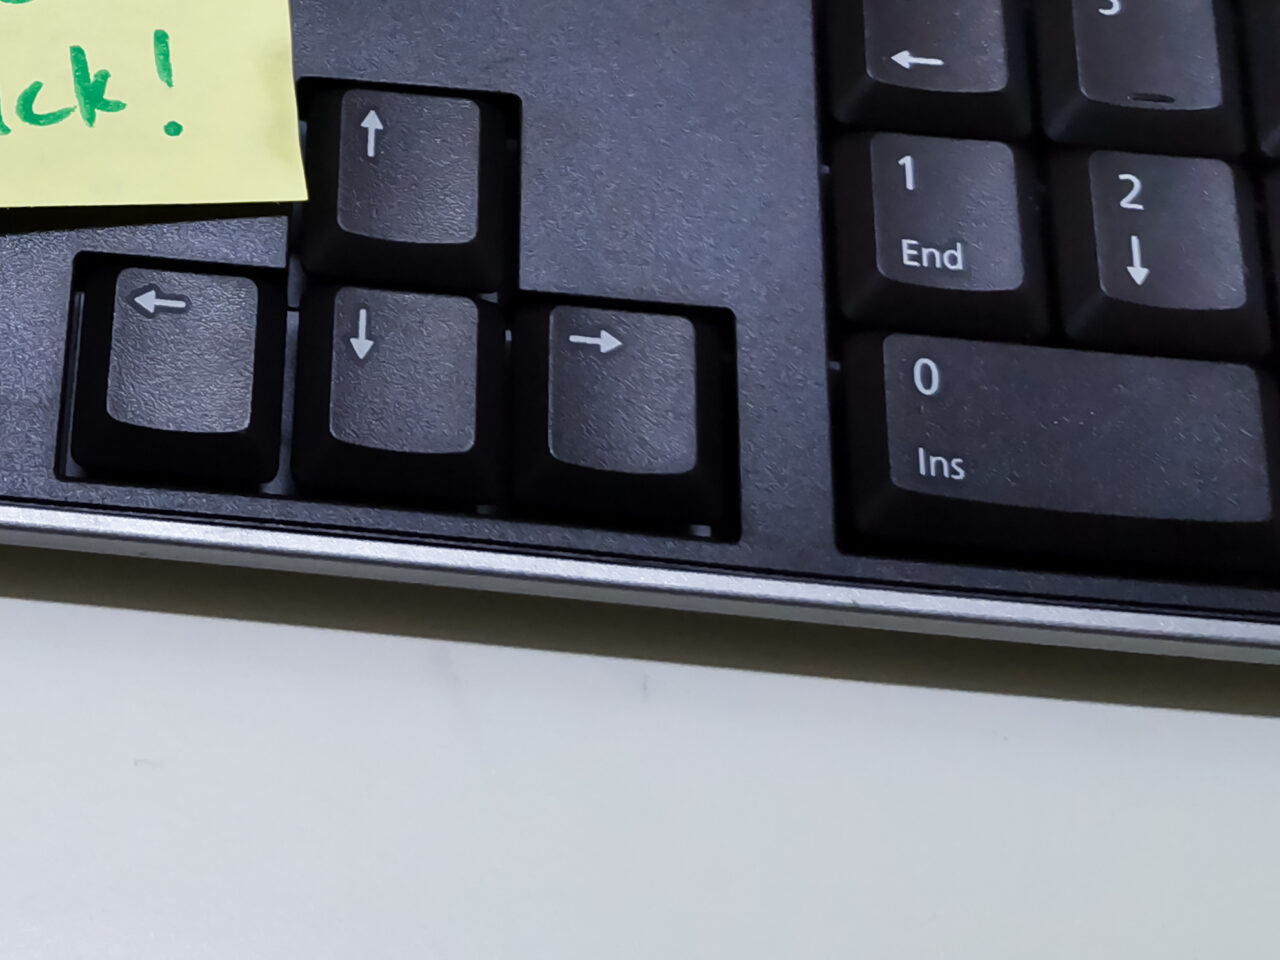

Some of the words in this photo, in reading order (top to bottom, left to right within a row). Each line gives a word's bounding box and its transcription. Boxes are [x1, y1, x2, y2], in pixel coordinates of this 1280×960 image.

[897, 154, 916, 191] 1
[1117, 172, 1146, 211] 2
[900, 237, 965, 272] End
[912, 356, 941, 396] 0
[917, 446, 967, 481] Ins
